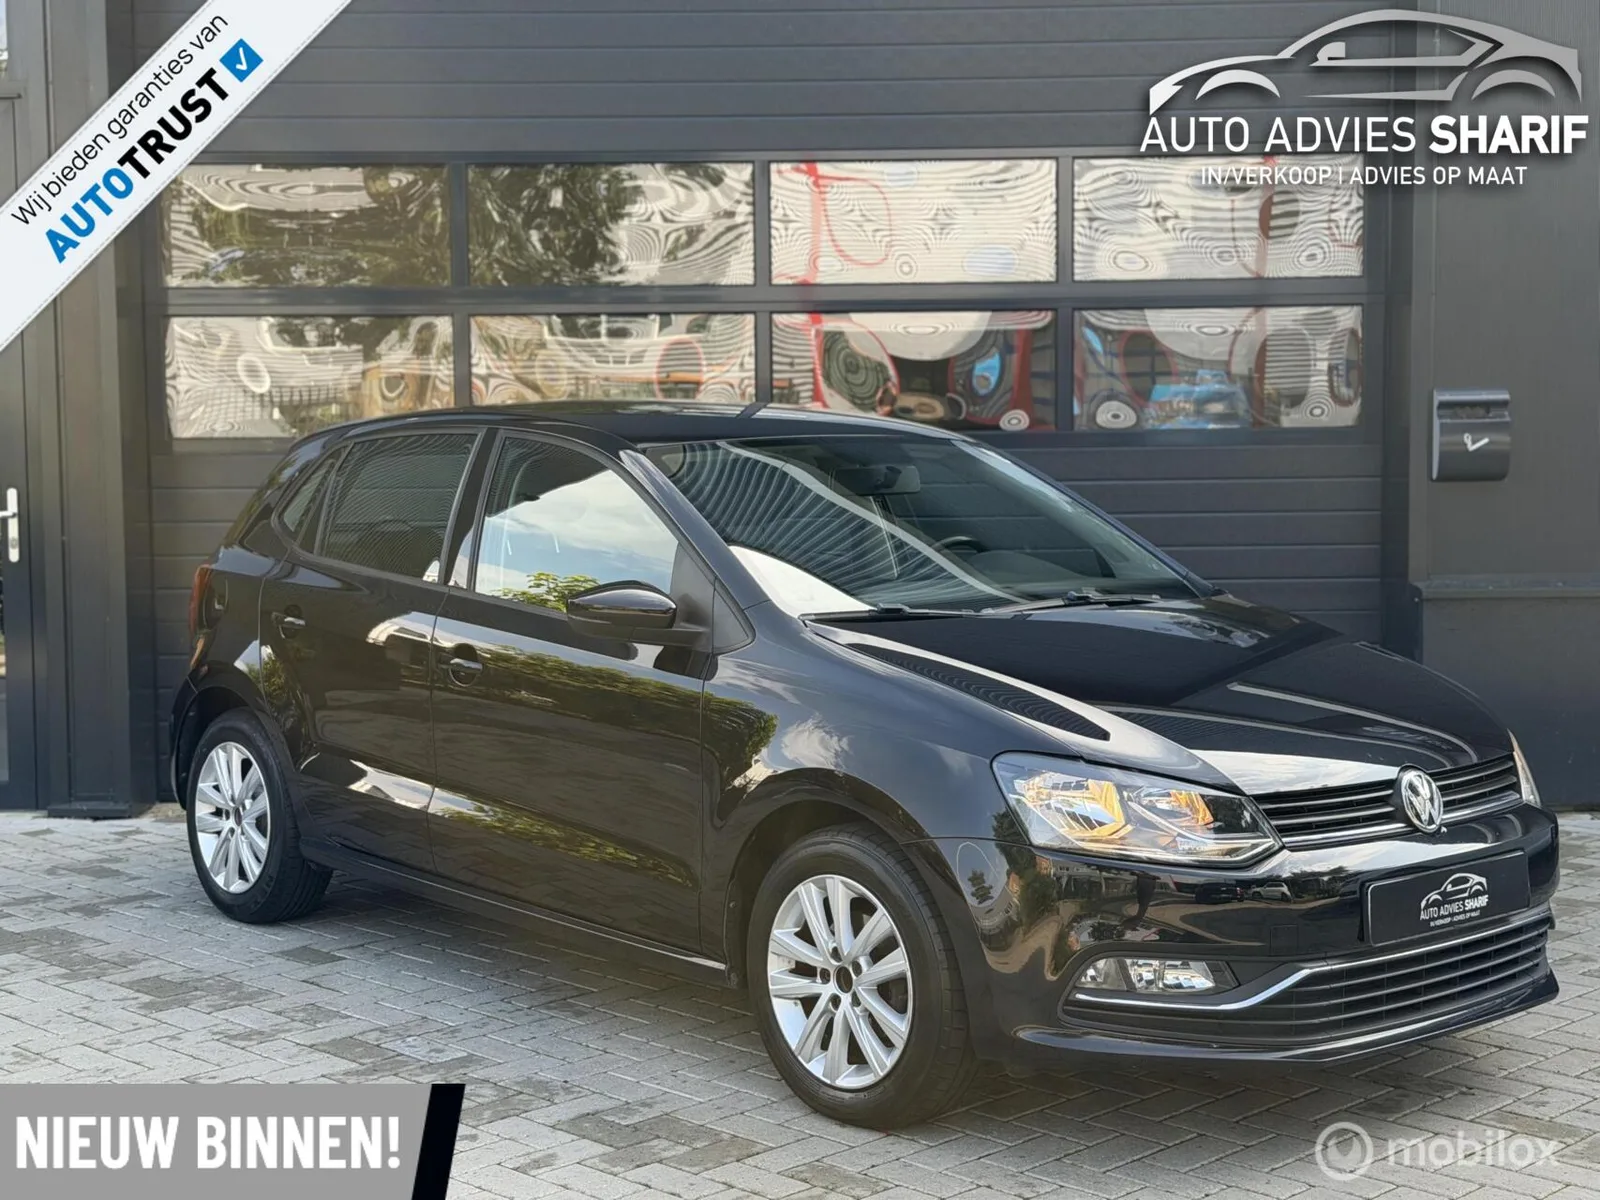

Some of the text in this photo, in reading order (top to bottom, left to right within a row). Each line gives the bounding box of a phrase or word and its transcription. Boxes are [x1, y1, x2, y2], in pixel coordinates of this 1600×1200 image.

[1420, 907, 1438, 920] AUTO
[1440, 901, 1464, 916] ADVIES
[1464, 894, 1489, 911] SHARIF
